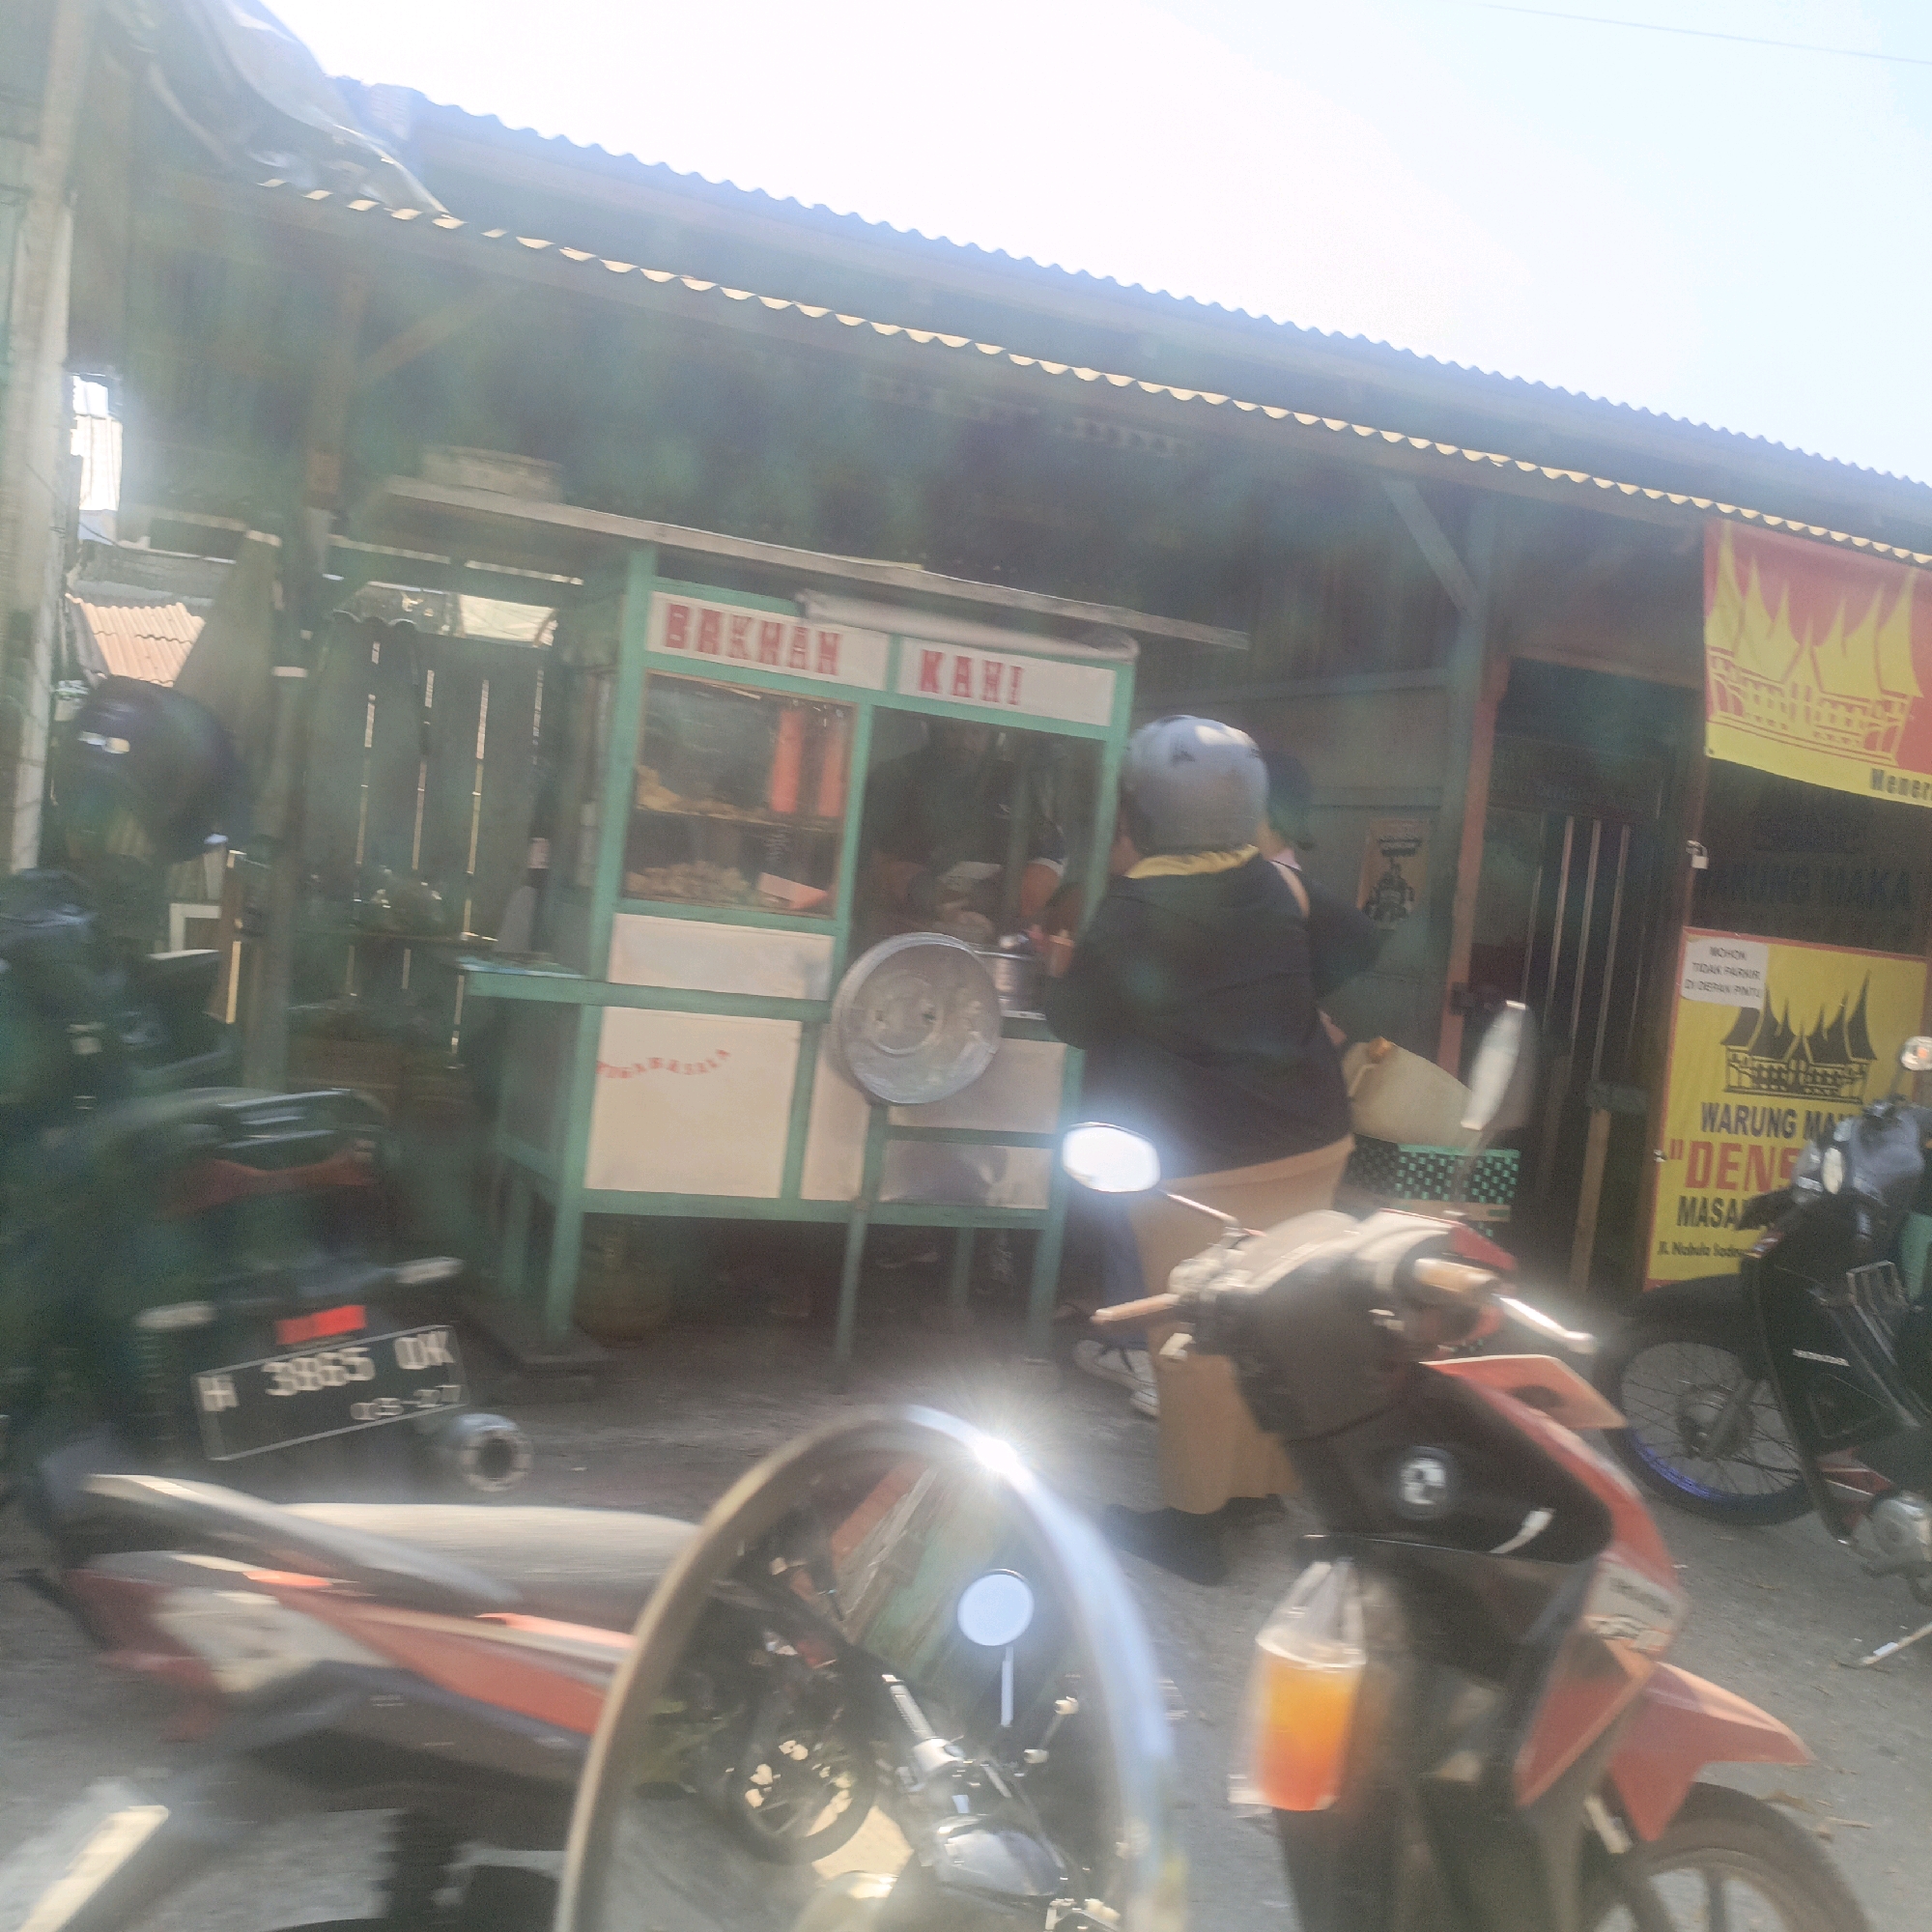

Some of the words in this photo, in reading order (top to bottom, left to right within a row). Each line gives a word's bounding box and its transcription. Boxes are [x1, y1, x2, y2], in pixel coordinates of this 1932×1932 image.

[1870, 768, 1932, 800] Mener
[1710, 947, 1747, 960] MOHON
[1692, 962, 1721, 975] TIDAK
[1724, 967, 1761, 980] PARKIR
[1684, 980, 1694, 989] DI
[1698, 980, 1731, 992] DEPAN
[1734, 985, 1762, 998] PINTU
[1701, 1102, 1797, 1139] WARUNG
[1669, 1139, 1800, 1192] "DENS
[1677, 1196, 1747, 1227] MASA
[261, 1348, 376, 1396] 3865
